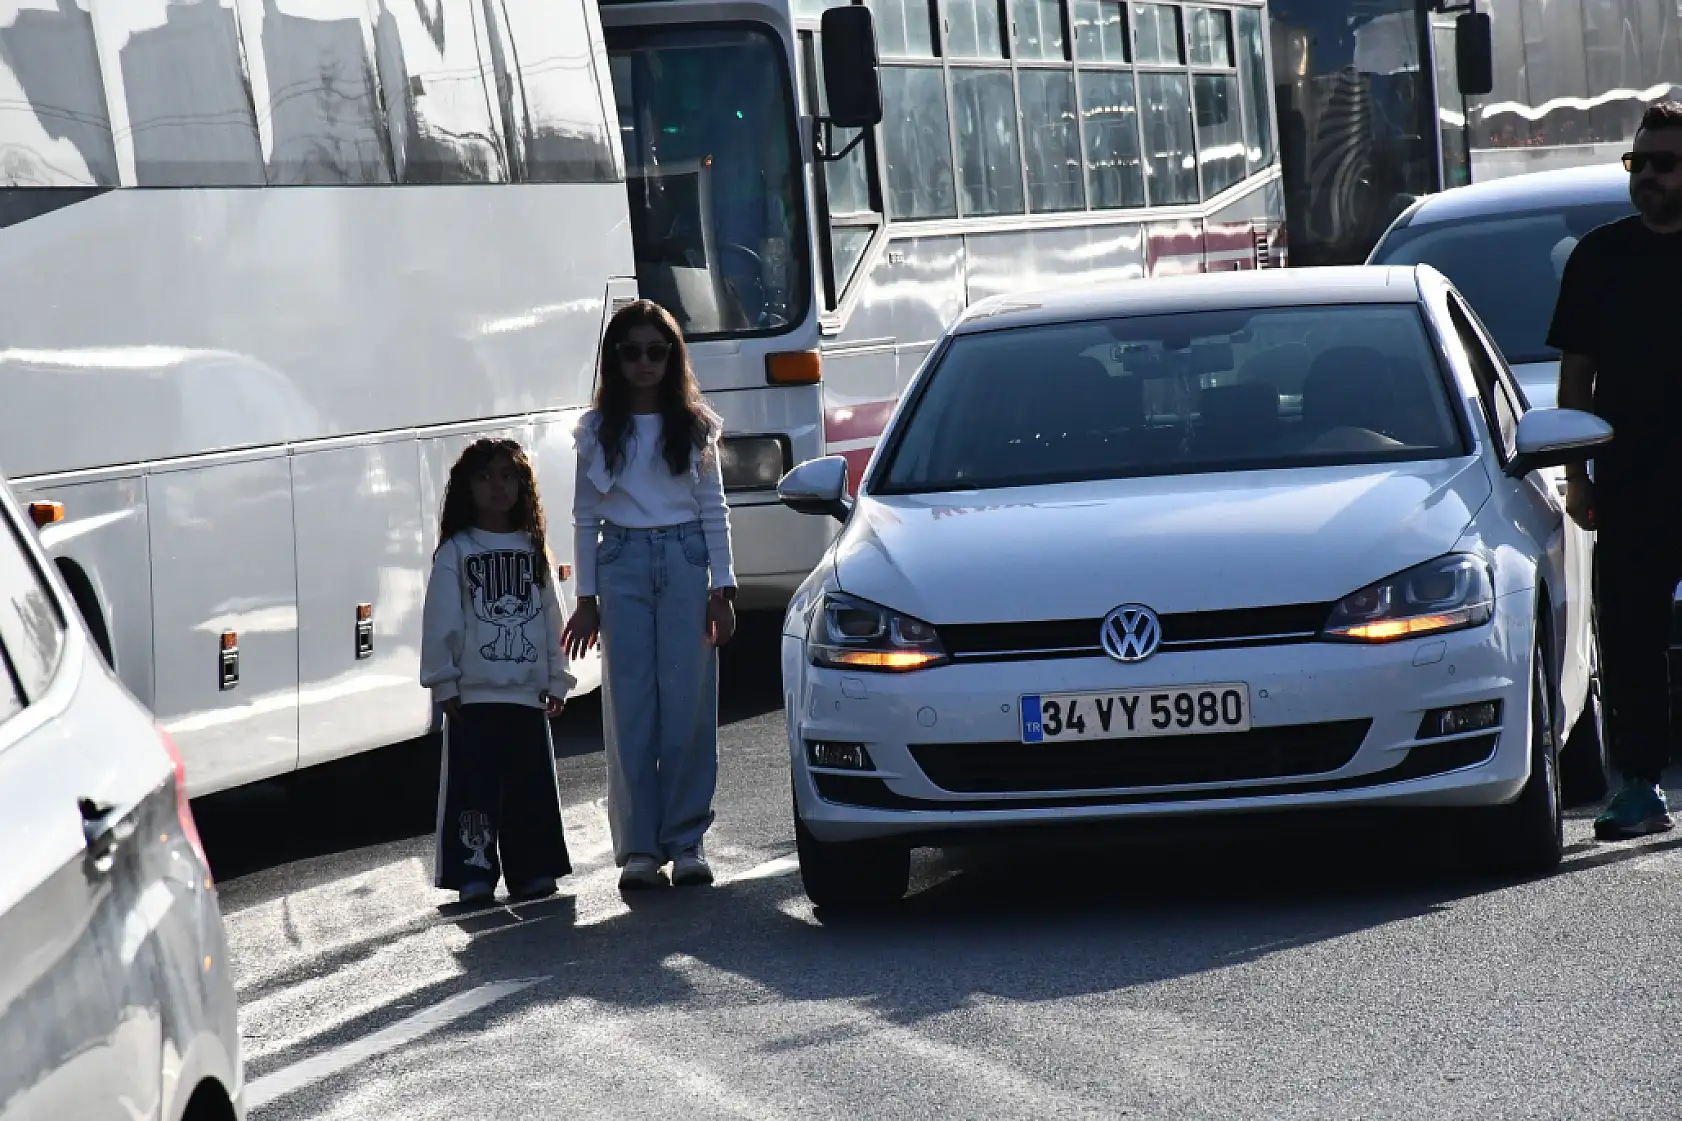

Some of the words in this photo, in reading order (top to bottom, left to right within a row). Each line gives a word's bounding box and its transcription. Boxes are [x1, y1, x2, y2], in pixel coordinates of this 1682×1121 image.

[1103, 605, 1160, 660] VW
[1025, 721, 1041, 733] TR
[1041, 700, 1085, 736] 34
[1095, 695, 1140, 732] VY
[1150, 689, 1242, 729] 5980
